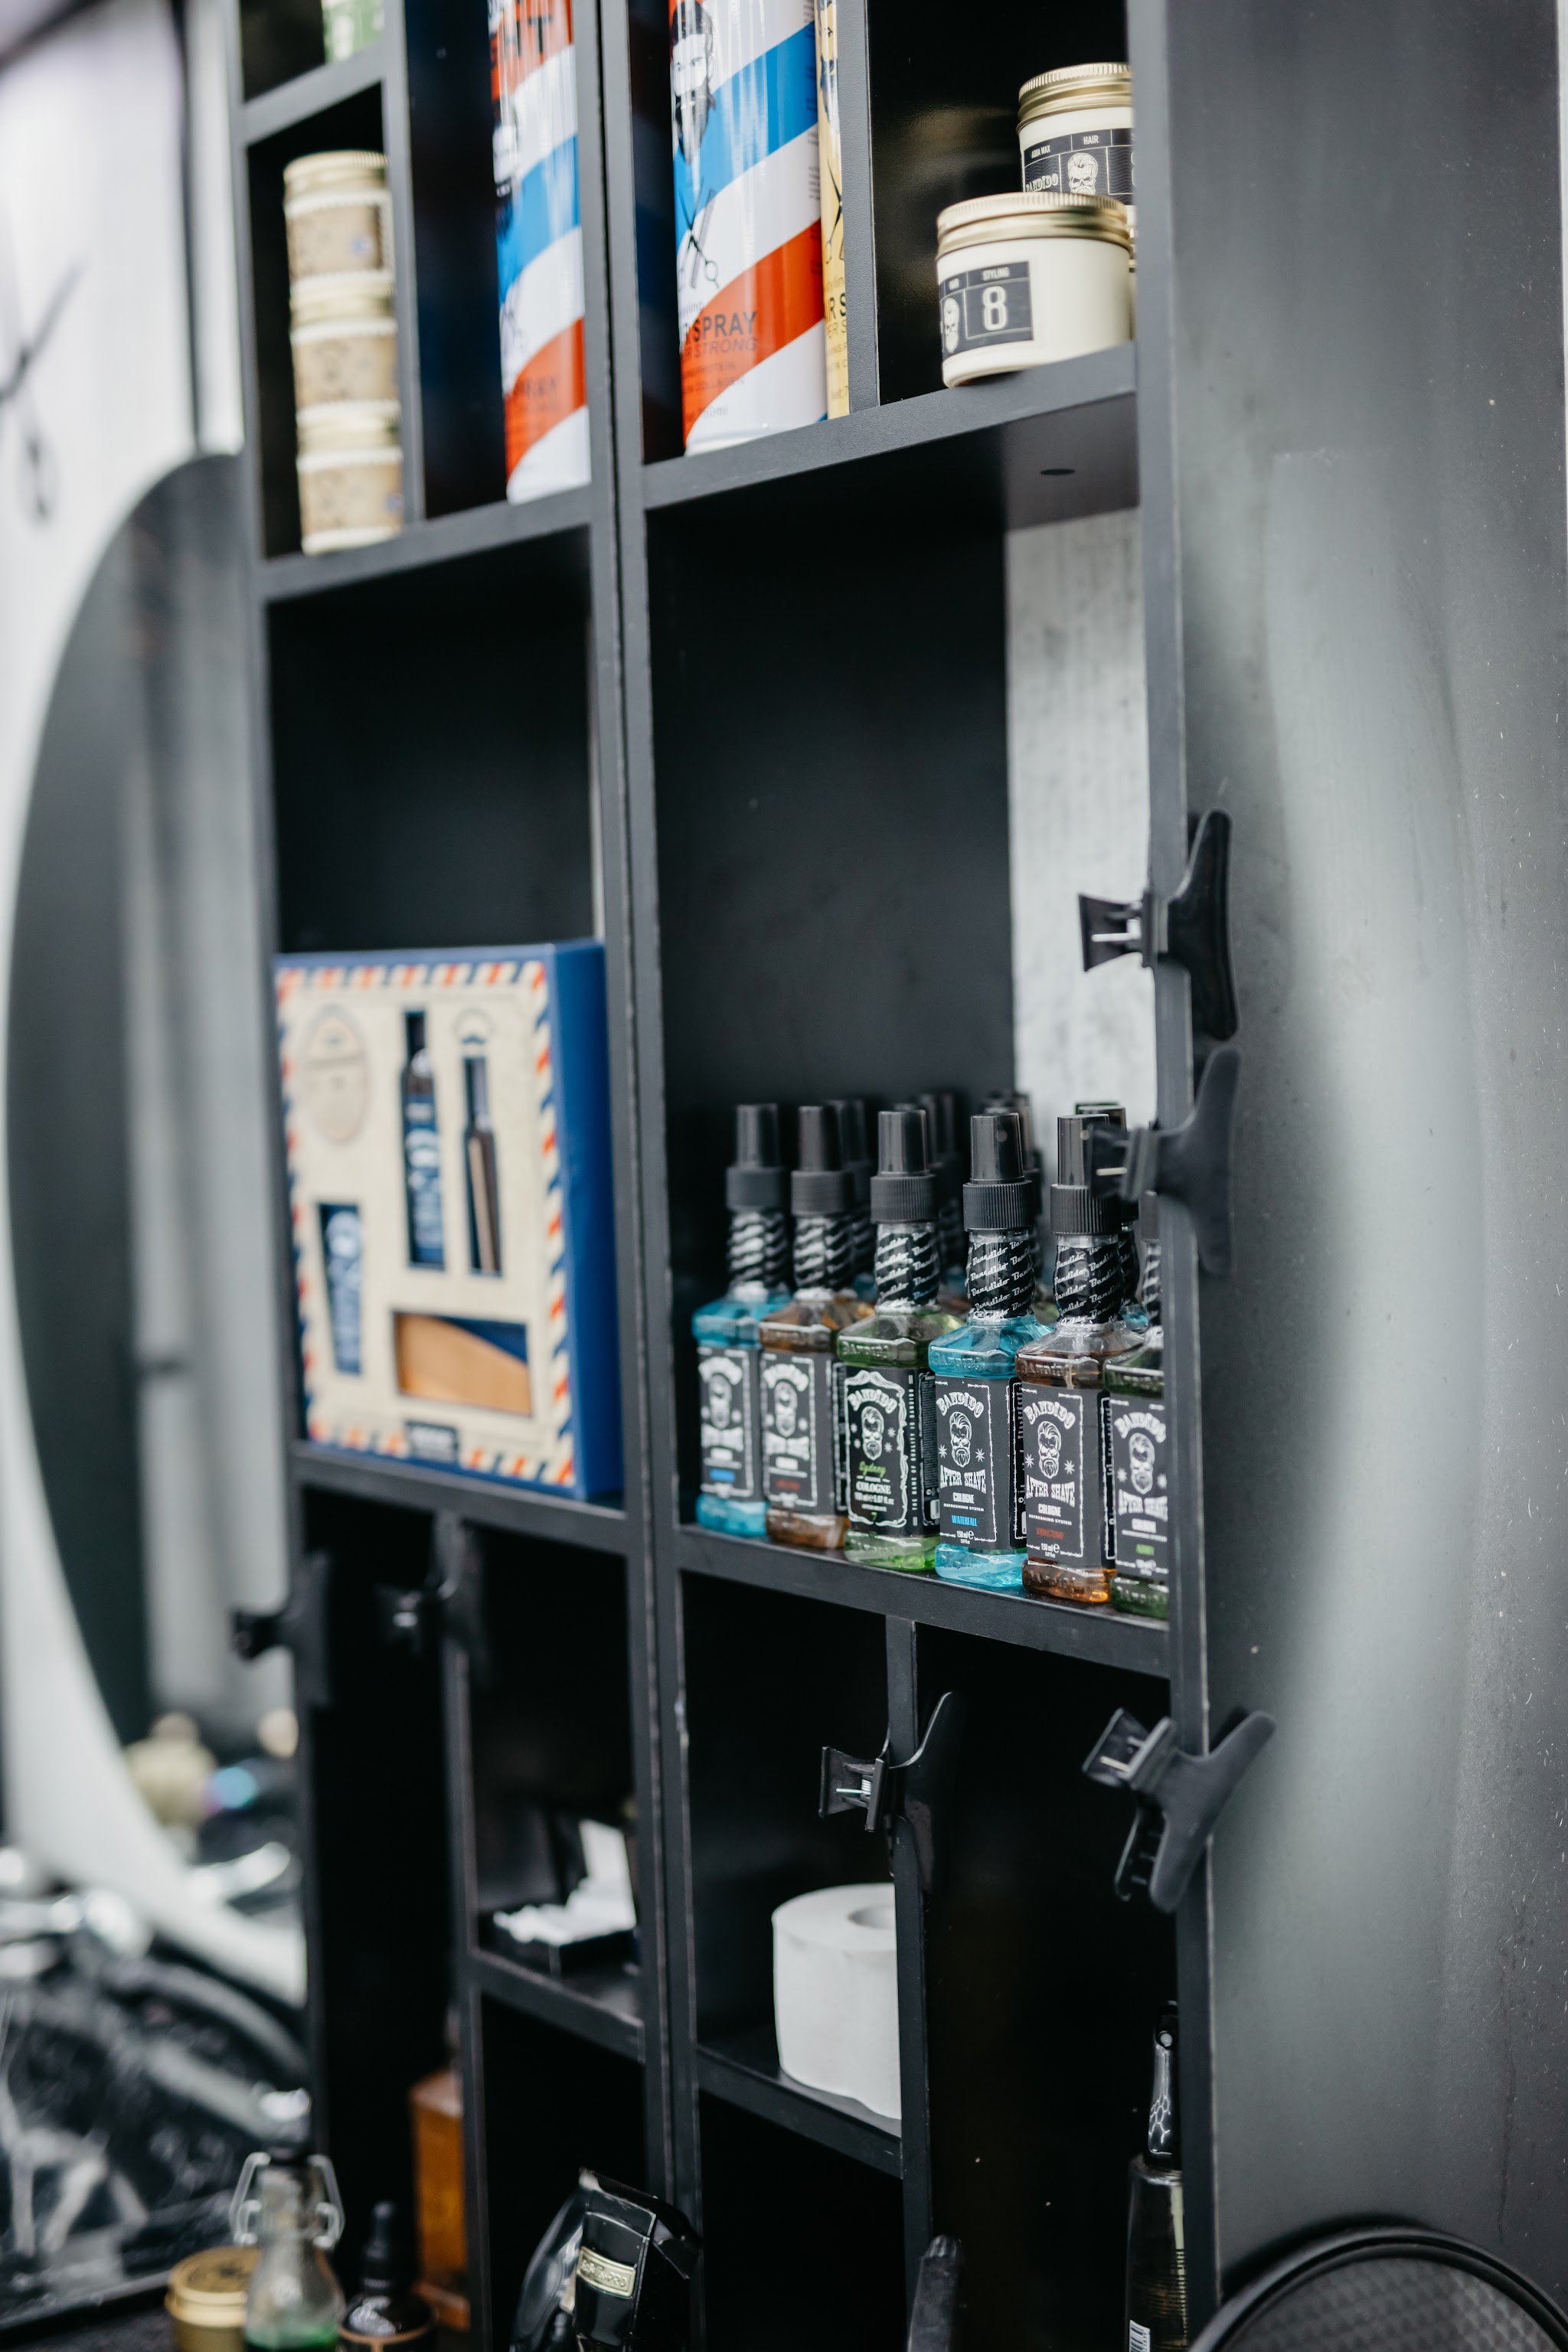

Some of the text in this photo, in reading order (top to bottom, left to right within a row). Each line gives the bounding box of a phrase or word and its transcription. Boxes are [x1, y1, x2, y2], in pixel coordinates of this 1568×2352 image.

[1083, 135, 1099, 145] HAIR
[1040, 145, 1050, 155] WAX
[982, 286, 1008, 332] 8
[694, 311, 756, 341] SPRAY
[940, 1465, 986, 1494] AFTER SHAVE
[856, 1481, 891, 1495] COLOGNE
[1026, 1475, 1075, 1508] AFTER SHAVE
[952, 1492, 975, 1504] COLOGNE
[1038, 1504, 1061, 1517] COLOGNE
[951, 1515, 978, 1527] WATERFALL
[1028, 1514, 1054, 1523] REFRESHING
